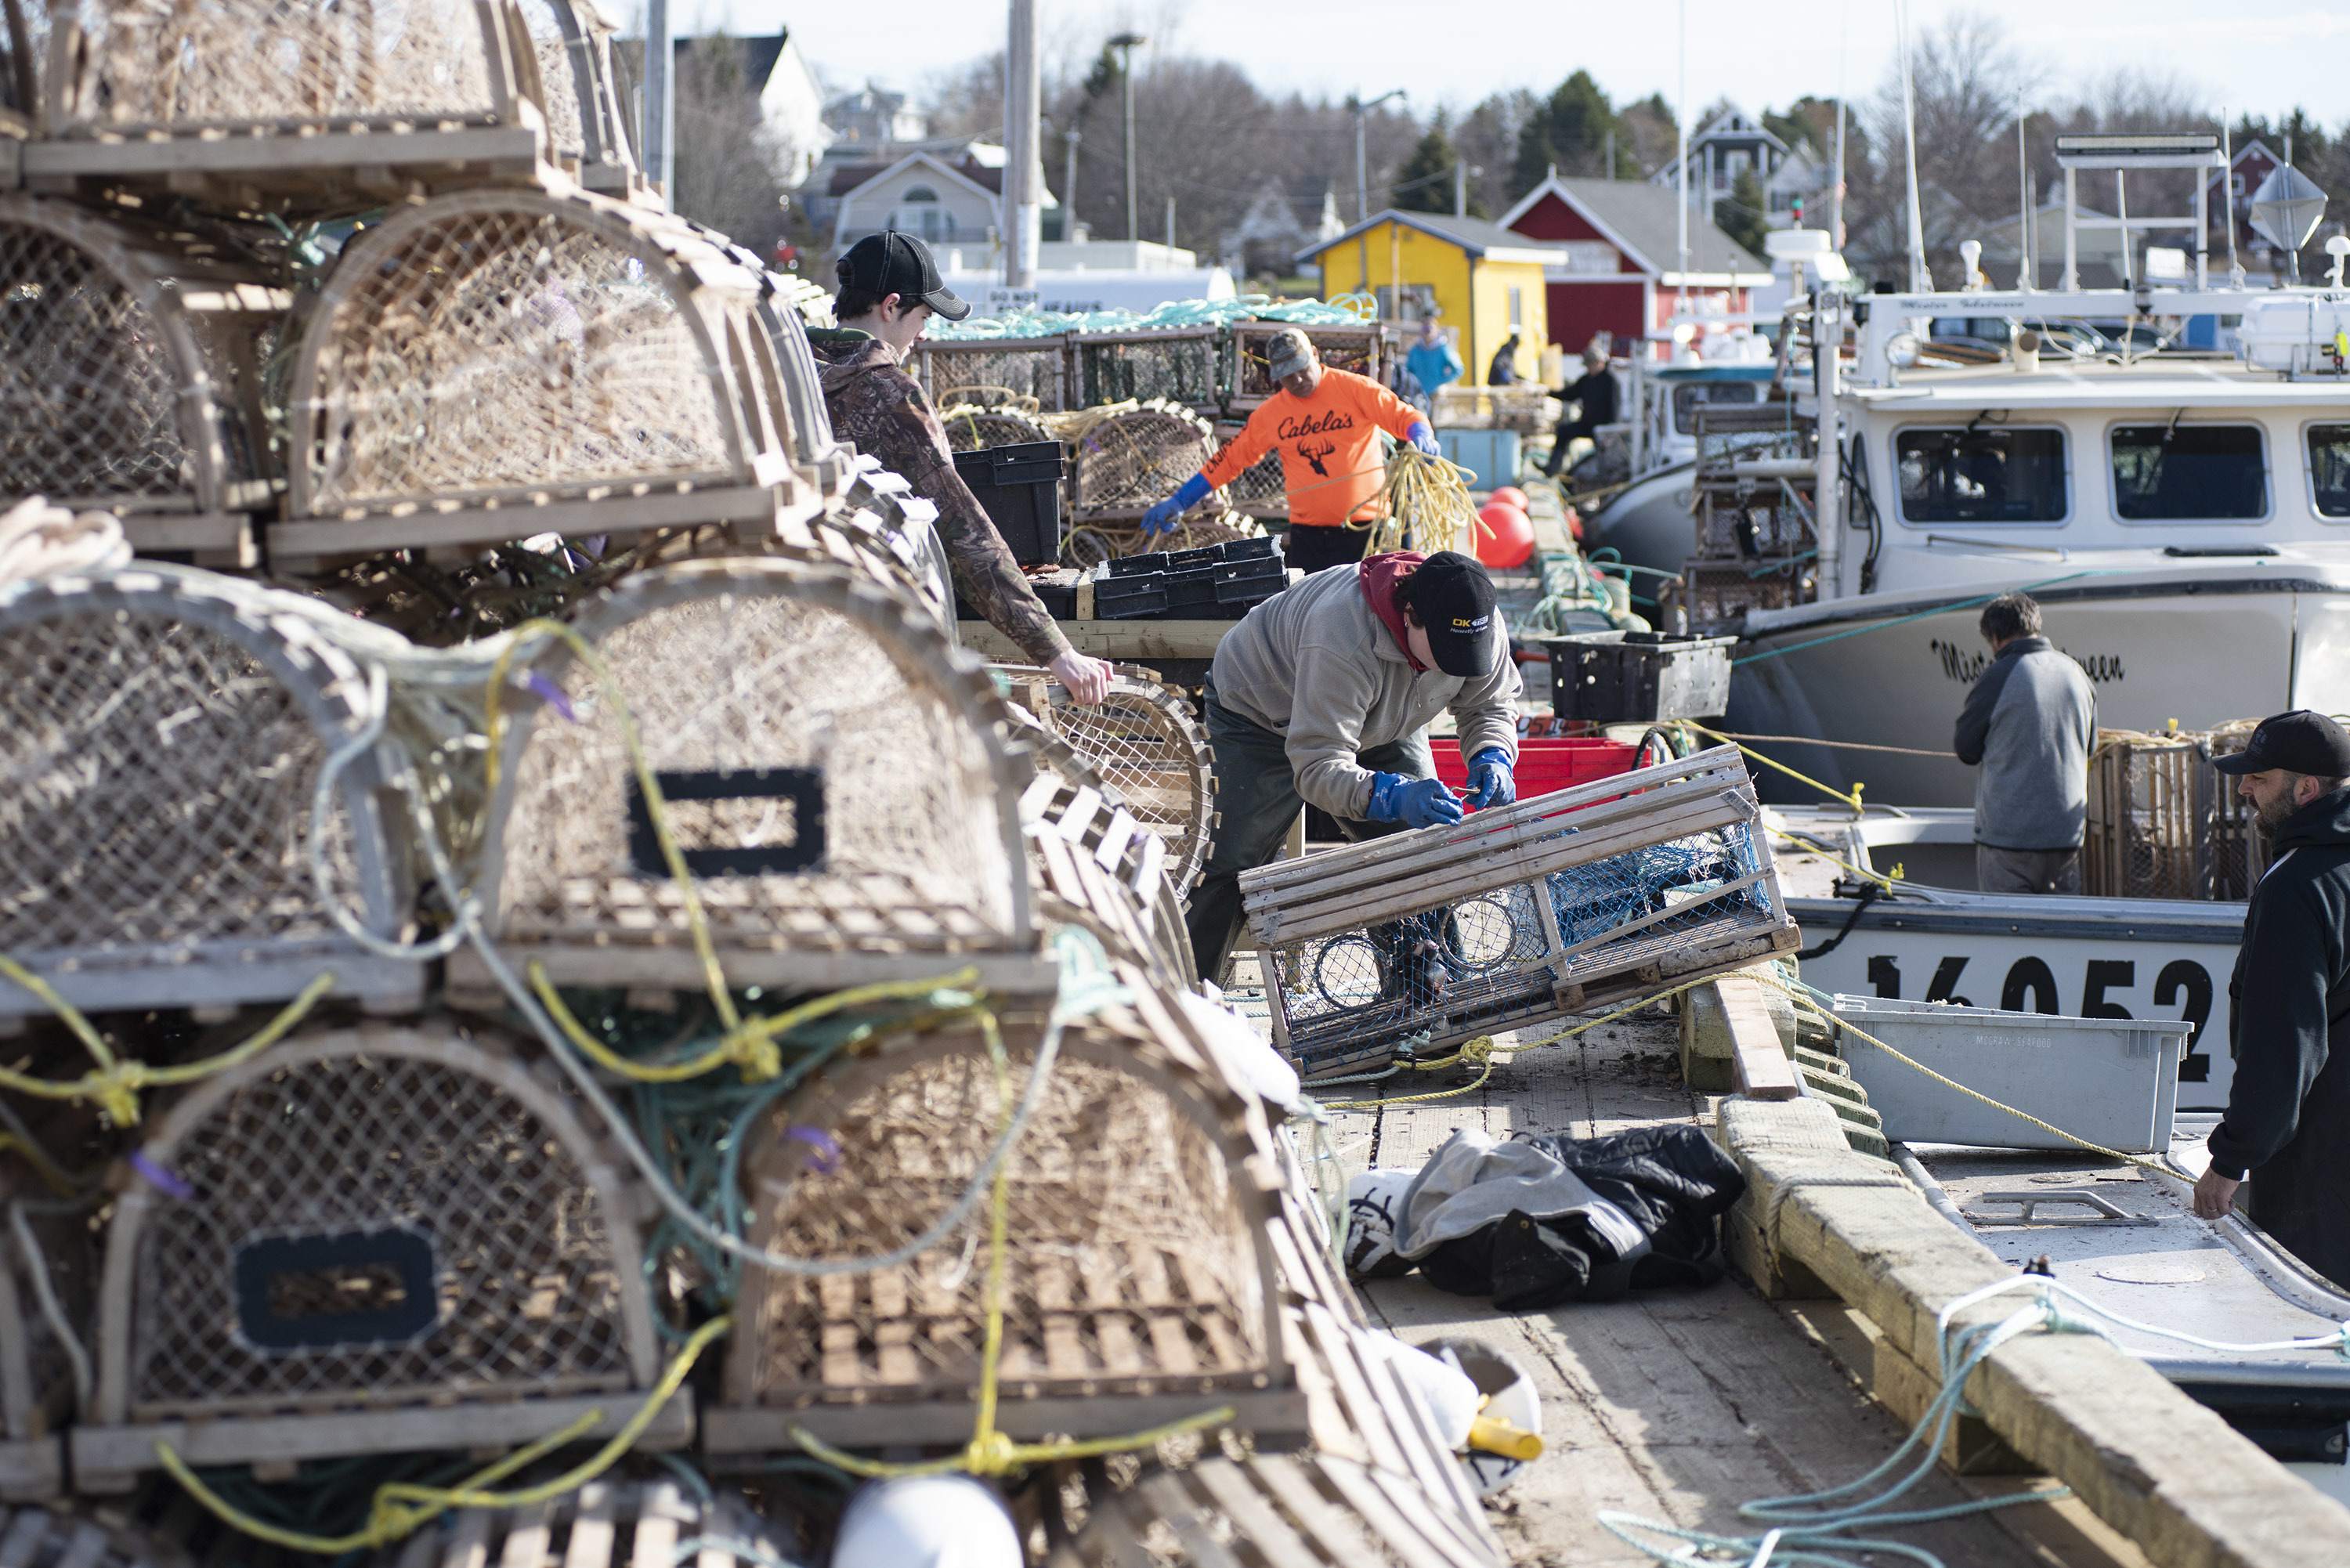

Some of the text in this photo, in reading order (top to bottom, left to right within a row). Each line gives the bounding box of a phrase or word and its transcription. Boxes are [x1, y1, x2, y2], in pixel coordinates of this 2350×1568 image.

[1278, 409, 1353, 440] Cabela's
[1452, 618, 1471, 627] OK
[1930, 638, 1994, 684] Mist
